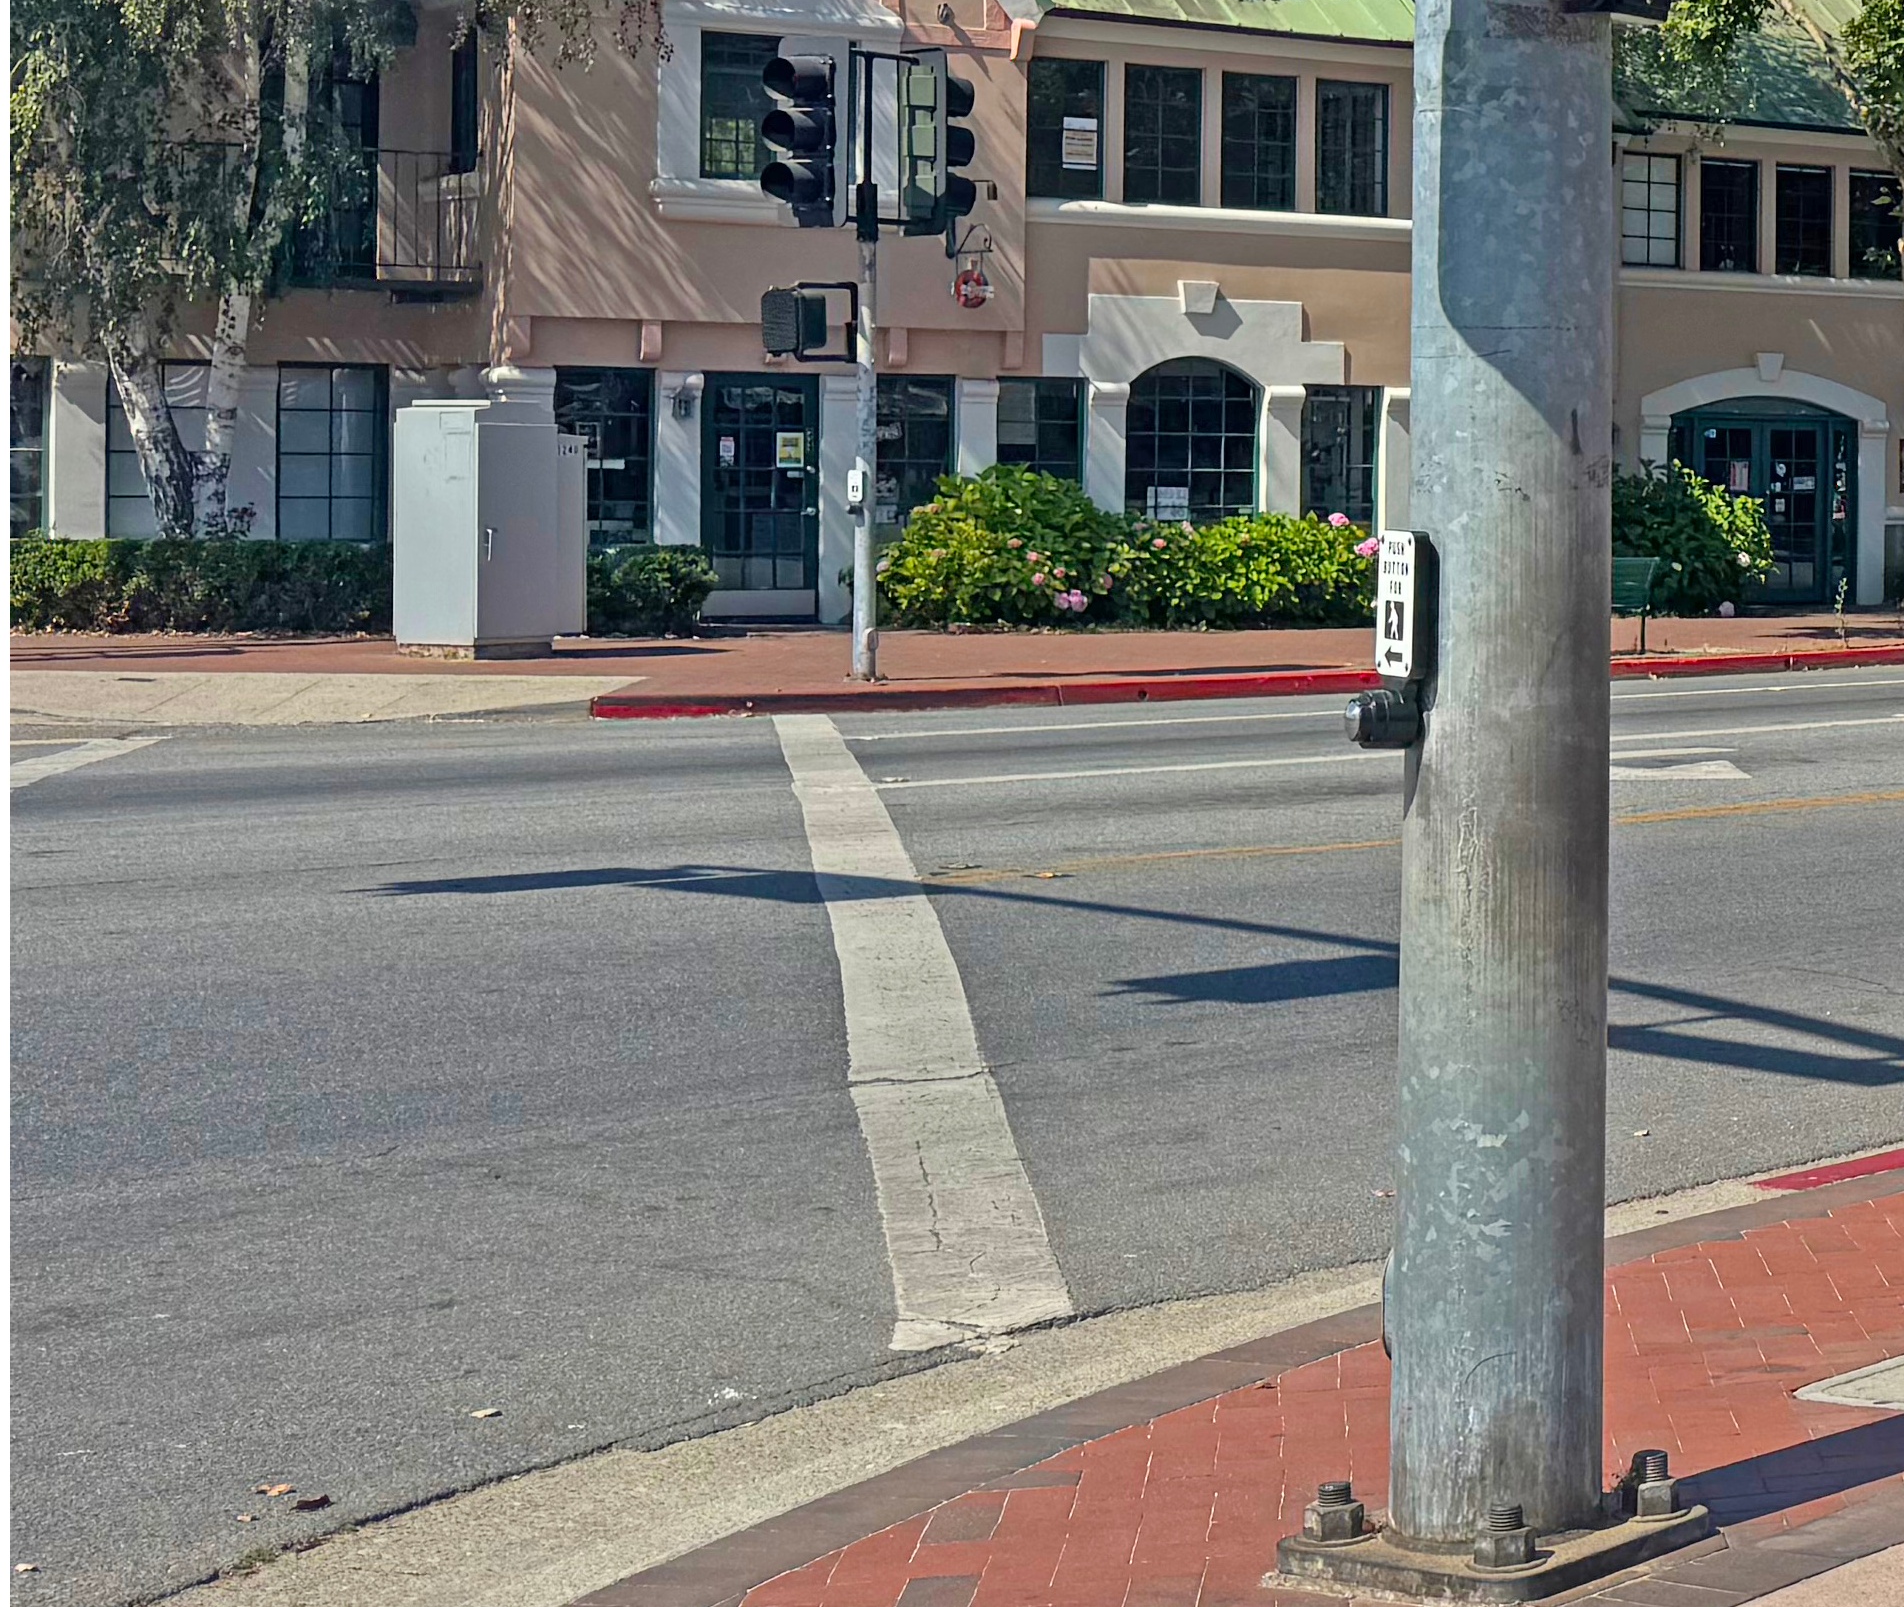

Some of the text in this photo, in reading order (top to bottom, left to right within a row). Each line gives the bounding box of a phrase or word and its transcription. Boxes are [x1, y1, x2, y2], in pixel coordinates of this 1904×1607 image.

[1388, 541, 1405, 556] PUSH
[1383, 561, 1409, 576] BUTTON
[1389, 580, 1402, 595] FOR
